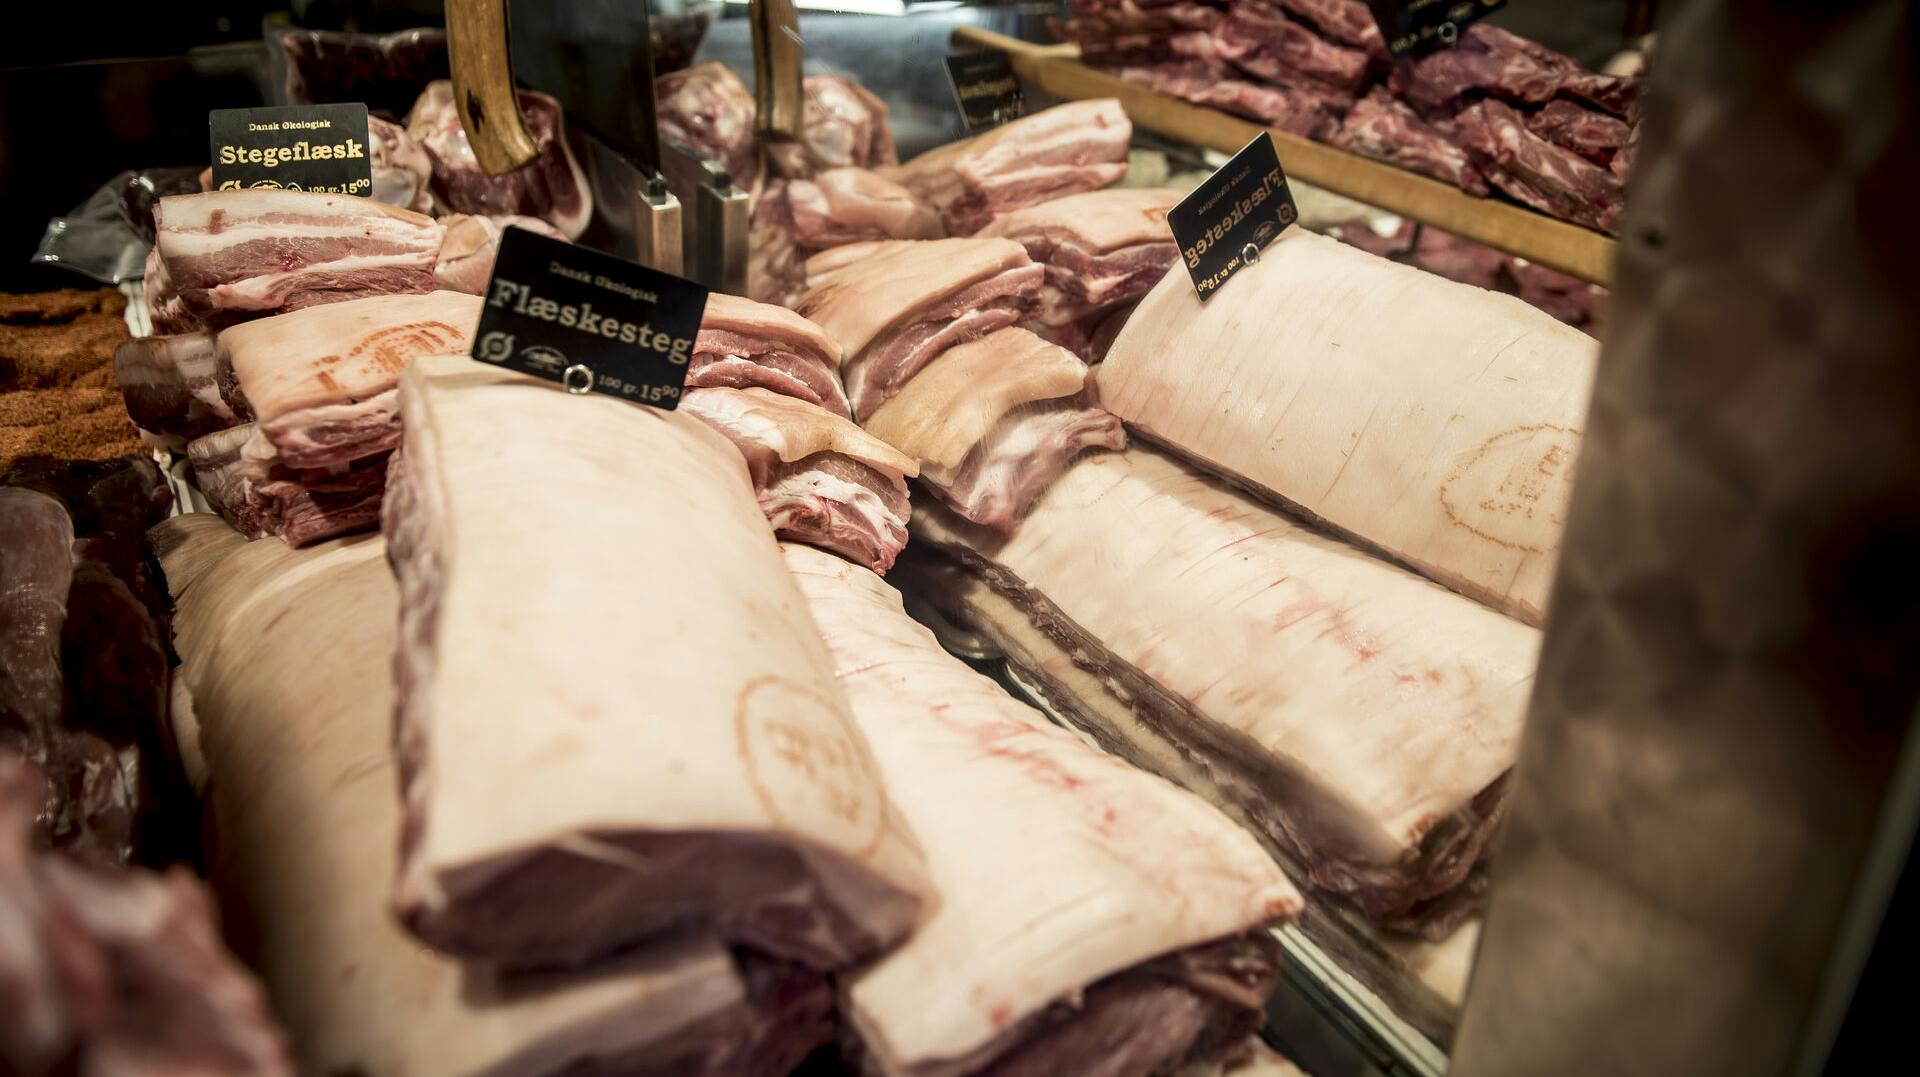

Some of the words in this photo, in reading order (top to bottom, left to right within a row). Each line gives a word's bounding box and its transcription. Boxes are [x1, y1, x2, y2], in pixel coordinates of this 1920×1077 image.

[249, 123, 280, 131] Dansk
[282, 119, 331, 130] Økologisk
[219, 138, 364, 168] Stegeflæsk
[548, 261, 592, 283] Dansk
[594, 275, 658, 304] Økologisk
[488, 277, 693, 366] Flæskesteg
[599, 374, 622, 389] 100
